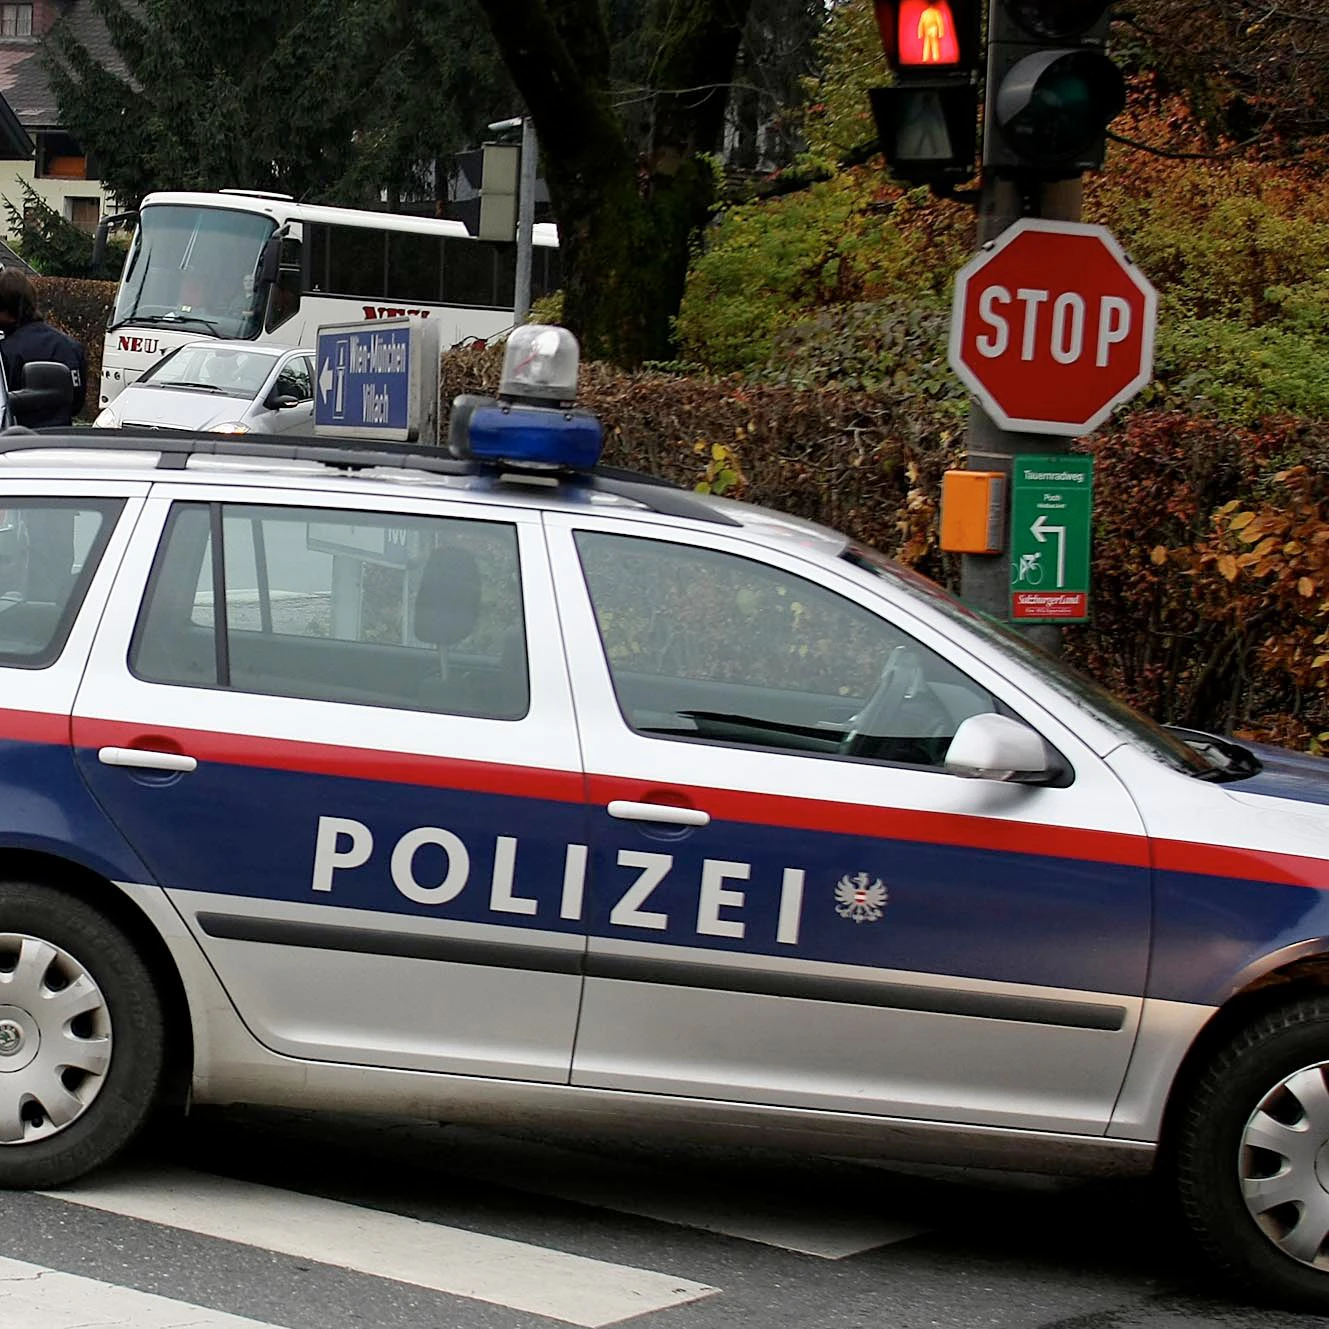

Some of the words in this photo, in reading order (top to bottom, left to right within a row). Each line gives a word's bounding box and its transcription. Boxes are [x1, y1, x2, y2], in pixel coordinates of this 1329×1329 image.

[117, 335, 160, 354] NEU
[975, 285, 1132, 368] STOP
[362, 383, 389, 424] Villach
[1023, 469, 1086, 484] Tauernradweg
[312, 816, 806, 945] POLIZEI
